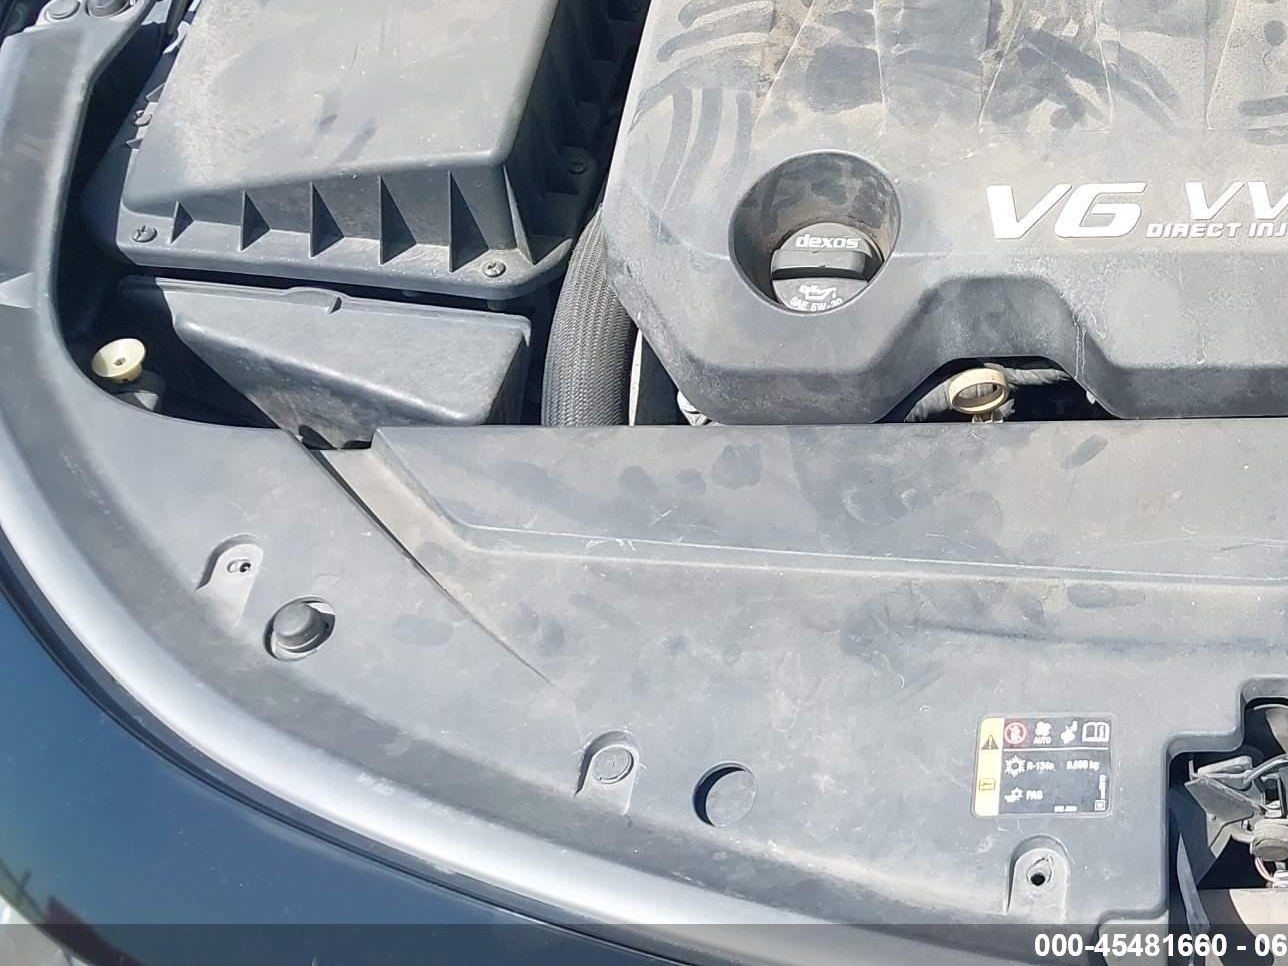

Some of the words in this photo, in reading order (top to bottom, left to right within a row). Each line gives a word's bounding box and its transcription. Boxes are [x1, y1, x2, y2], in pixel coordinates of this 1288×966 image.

[986, 182, 1147, 240] V6
[1145, 222, 1241, 239] DIRECT
[796, 234, 861, 249] dexos
